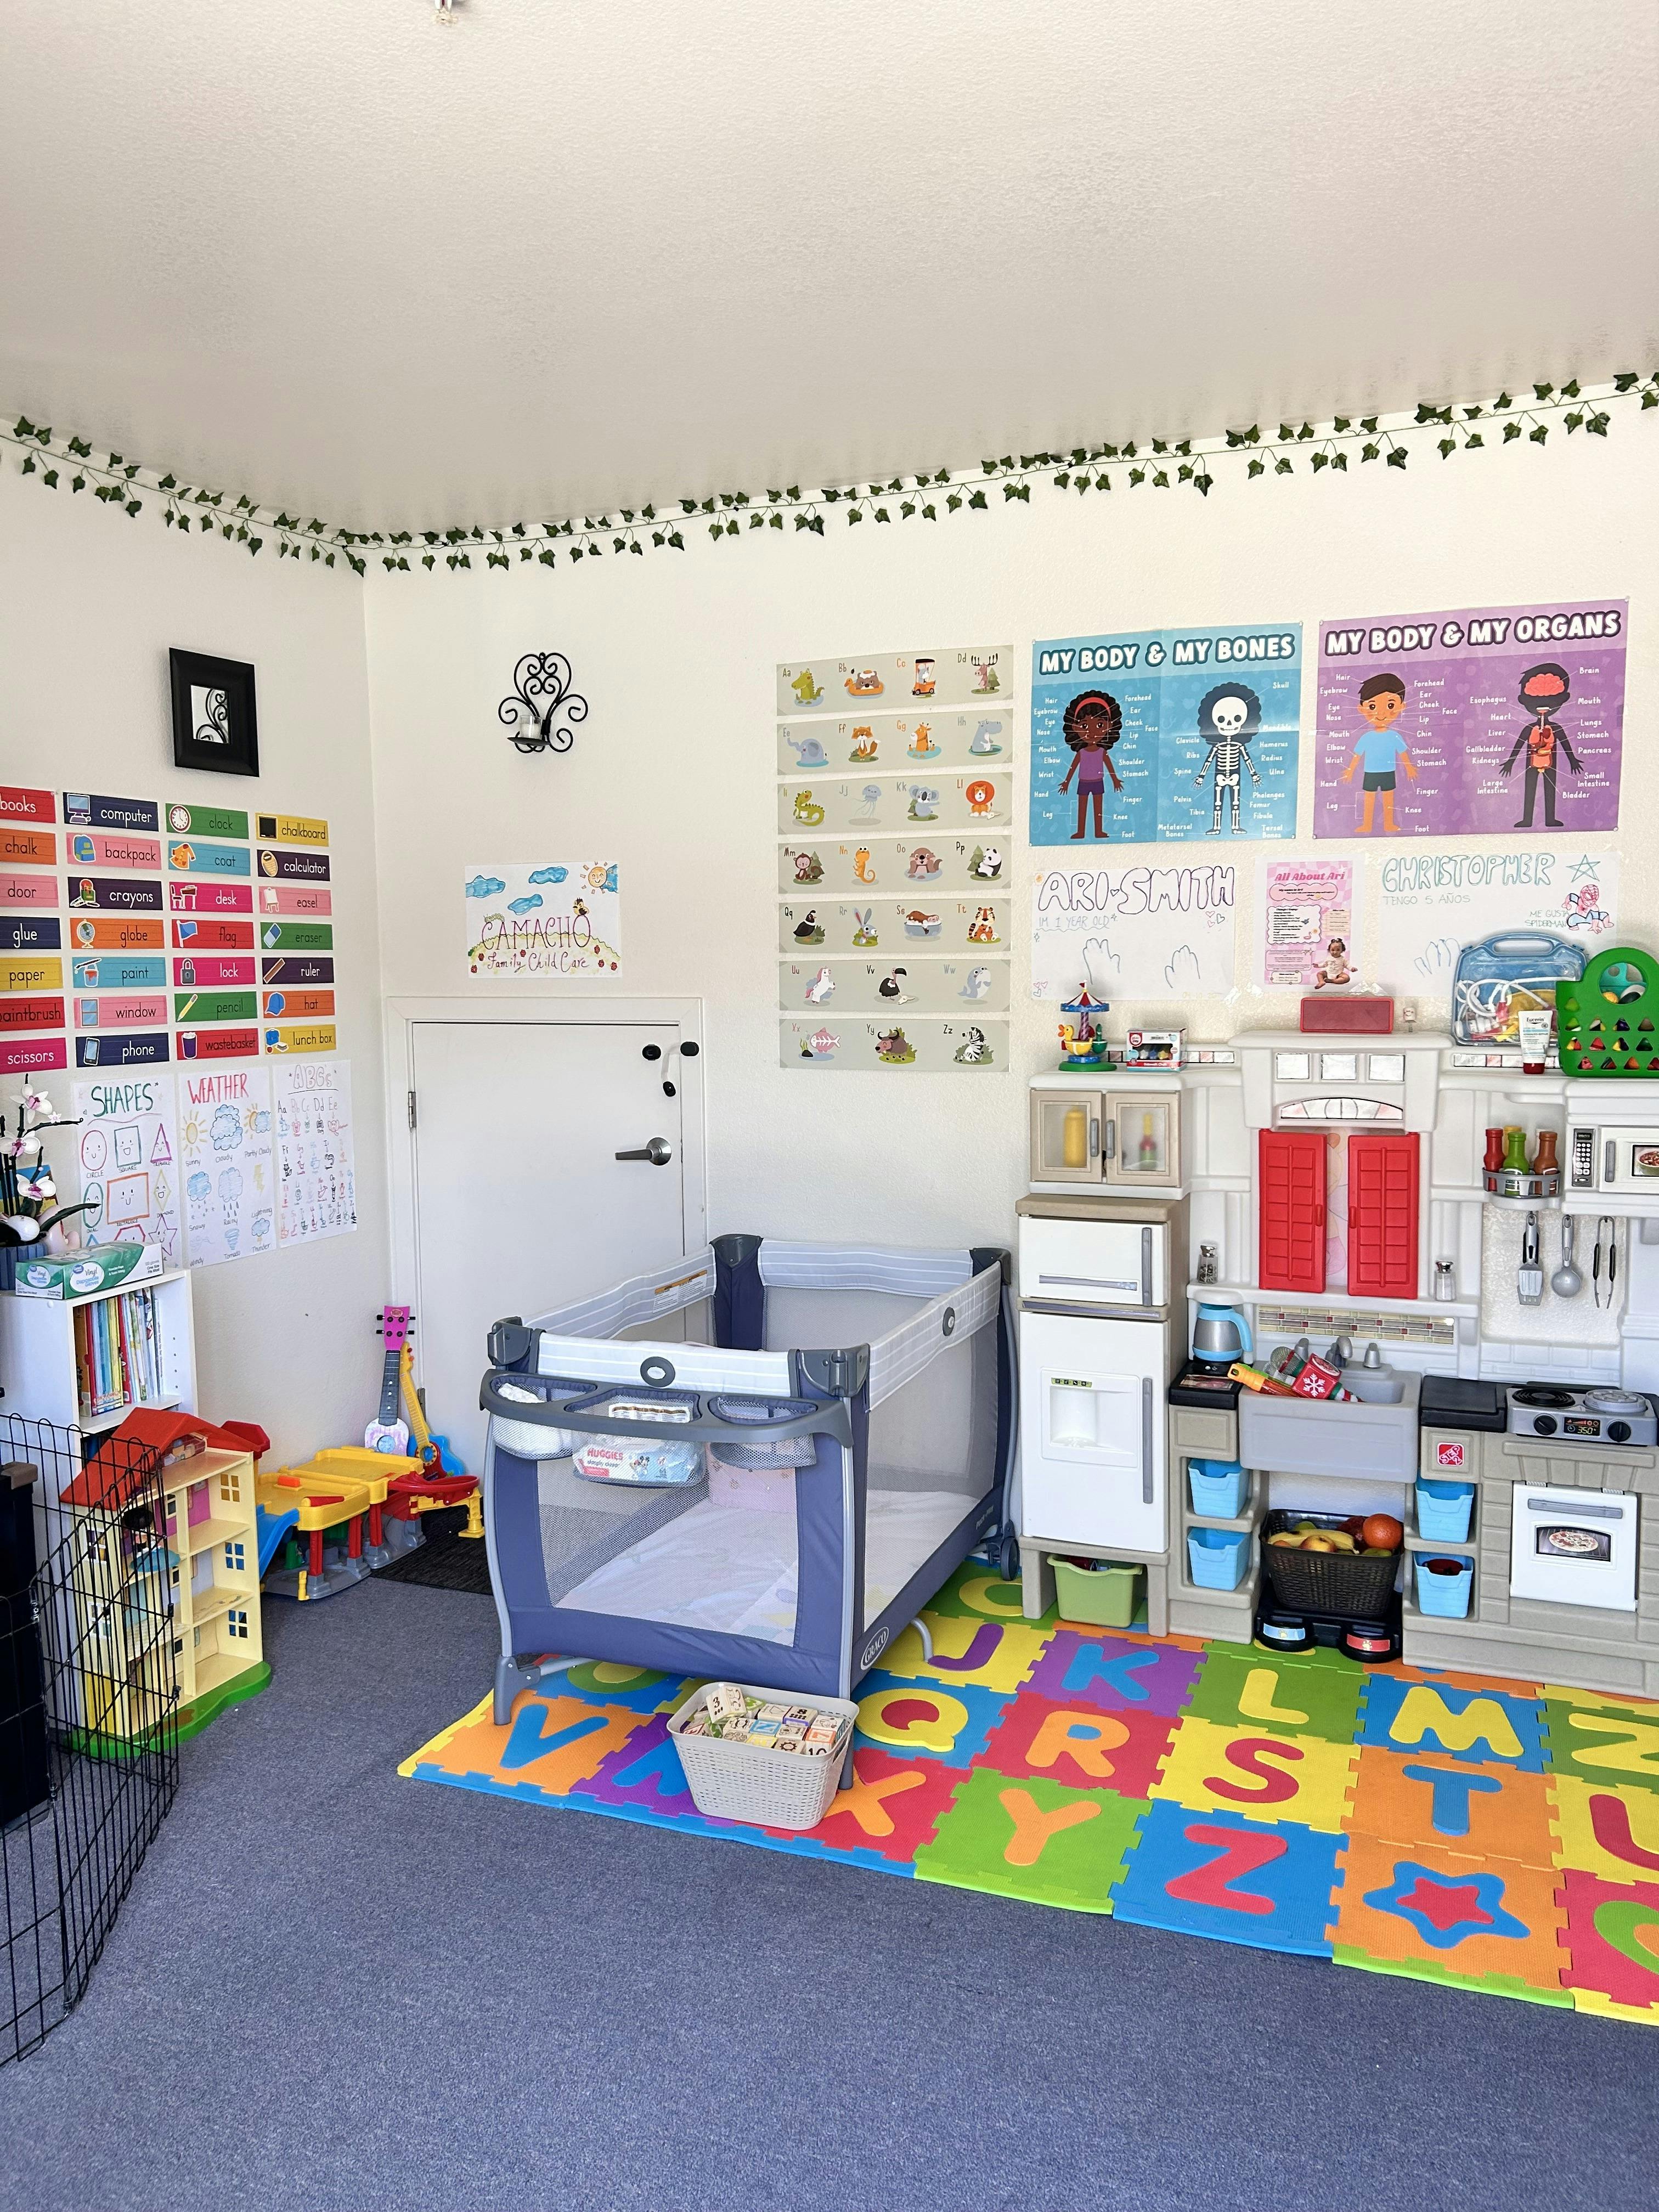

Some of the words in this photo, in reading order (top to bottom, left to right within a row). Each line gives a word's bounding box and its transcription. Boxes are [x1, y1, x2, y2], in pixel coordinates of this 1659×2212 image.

[1327, 631, 1364, 654] MY
[1371, 625, 1435, 651] BODY
[1442, 623, 1463, 647] &
[1470, 620, 1510, 644] MY
[1516, 612, 1620, 640] ORGANS
[1041, 651, 1074, 673] MY
[1081, 645, 1138, 670] BODY
[1147, 643, 1165, 665] &
[1174, 640, 1210, 663] MY
[1217, 635, 1293, 661] BONES
[783, 668, 791, 678] Aa
[838, 663, 847, 673] Bb
[896, 658, 906, 668] Cc
[957, 653, 966, 663] Dd
[1321, 687, 1348, 695] Eyebrow
[1470, 696, 1507, 706] Esophagus
[783, 727, 790, 737] Ee
[838, 724, 847, 733] Ff
[896, 720, 906, 731] Gg
[957, 716, 966, 726] Hh
[1580, 719, 1602, 729] Lungs
[1577, 731, 1609, 740] Stomach
[1174, 768, 1192, 776] Spine
[1483, 780, 1503, 788] Large
[1173, 795, 1192, 804] Pelvis
[1417, 788, 1438, 797] Finger
[0, 793, 36, 813] books
[100, 807, 153, 827] computer
[209, 817, 233, 831] clock
[281, 823, 326, 840] chalkboard
[5, 835, 37, 854] chalk
[105, 843, 156, 867] backpack
[215, 856, 236, 867] coat
[284, 861, 326, 874] calculator
[1382, 853, 1555, 893] CHRISTOPHER
[1275, 872, 1291, 881] All
[1292, 872, 1325, 881] About
[1327, 871, 1346, 881] Ari
[8, 884, 36, 899] door
[1039, 872, 1109, 911] ARI
[1118, 866, 1235, 915] SMITH
[109, 889, 154, 910] crayons
[216, 893, 237, 906] desk
[297, 896, 318, 909] easel
[1382, 895, 1418, 905] TENGO
[1425, 894, 1433, 904] 5
[1438, 892, 1471, 904] AÑOS
[1545, 909, 1570, 918] GUSTA
[1056, 917, 1061, 928] 1
[1066, 916, 1088, 928] YEAR
[1093, 915, 1109, 927] OLD
[13, 922, 37, 949] glue
[120, 926, 148, 949] globe
[218, 927, 237, 949] flag
[295, 934, 323, 943] eraser
[481, 915, 591, 950] CAMACHO
[487, 952, 526, 973] Family
[528, 952, 558, 971] Child
[561, 951, 590, 972] Care
[791, 965, 800, 975] Uu
[866, 964, 875, 974] Vv
[944, 964, 956, 974] Ww
[121, 966, 149, 986] paint
[221, 963, 239, 978] lock
[301, 966, 320, 977] ruler
[9, 970, 45, 989] paper
[116, 1002, 156, 1018] window
[217, 1001, 244, 1020] pencil
[304, 998, 318, 1011] hat
[792, 1023, 800, 1032] Xx
[866, 1024, 875, 1036] Yy
[943, 1024, 953, 1035] Zz
[206, 1036, 256, 1051] wastebasket
[293, 1031, 317, 1046] lunch
[319, 1032, 332, 1045] box
[8, 1050, 54, 1065] scissors
[122, 1041, 155, 1064] phone
[187, 1073, 249, 1104] WEATHER
[91, 1082, 154, 1117] SHAPES
[278, 1100, 287, 1114] Aa
[291, 1098, 300, 1113] Bb
[302, 1098, 310, 1112] Cc
[313, 1097, 325, 1111] Dd
[329, 1097, 338, 1111] Ee
[216, 1154, 233, 1163] Cloudy
[244, 1149, 257, 1158] Partly
[258, 1146, 272, 1155] Cloudy
[185, 1159, 201, 1167] Sunny
[87, 1170, 104, 1179] CIRCLE
[251, 1207, 273, 1218] Lightning
[189, 1223, 205, 1231] Snowy
[224, 1250, 241, 1260] Tornado
[252, 1243, 270, 1252] Thunder
[190, 1257, 204, 1267] Windy
[84, 1267, 98, 1276] Vinyl
[587, 1447, 623, 1461] HUGGIES
[1439, 1444, 1461, 1464] STEP
[1453, 1457, 1463, 1465] 2
[865, 1630, 887, 1663] GRACO
[927, 1622, 1004, 1672] J
[1060, 1643, 1160, 1701] K
[713, 1696, 720, 1708] 3
[1238, 1668, 1310, 1724] L
[854, 1688, 969, 1752] Q
[1389, 1685, 1525, 1757] M
[501, 1703, 611, 1770] V
[1025, 1709, 1131, 1778] R
[1203, 1737, 1305, 1803] S
[824, 1760, 927, 1837] X
[1402, 1764, 1503, 1836] T
[997, 1788, 1102, 1866] Y
[1165, 1824, 1288, 1915] Z
